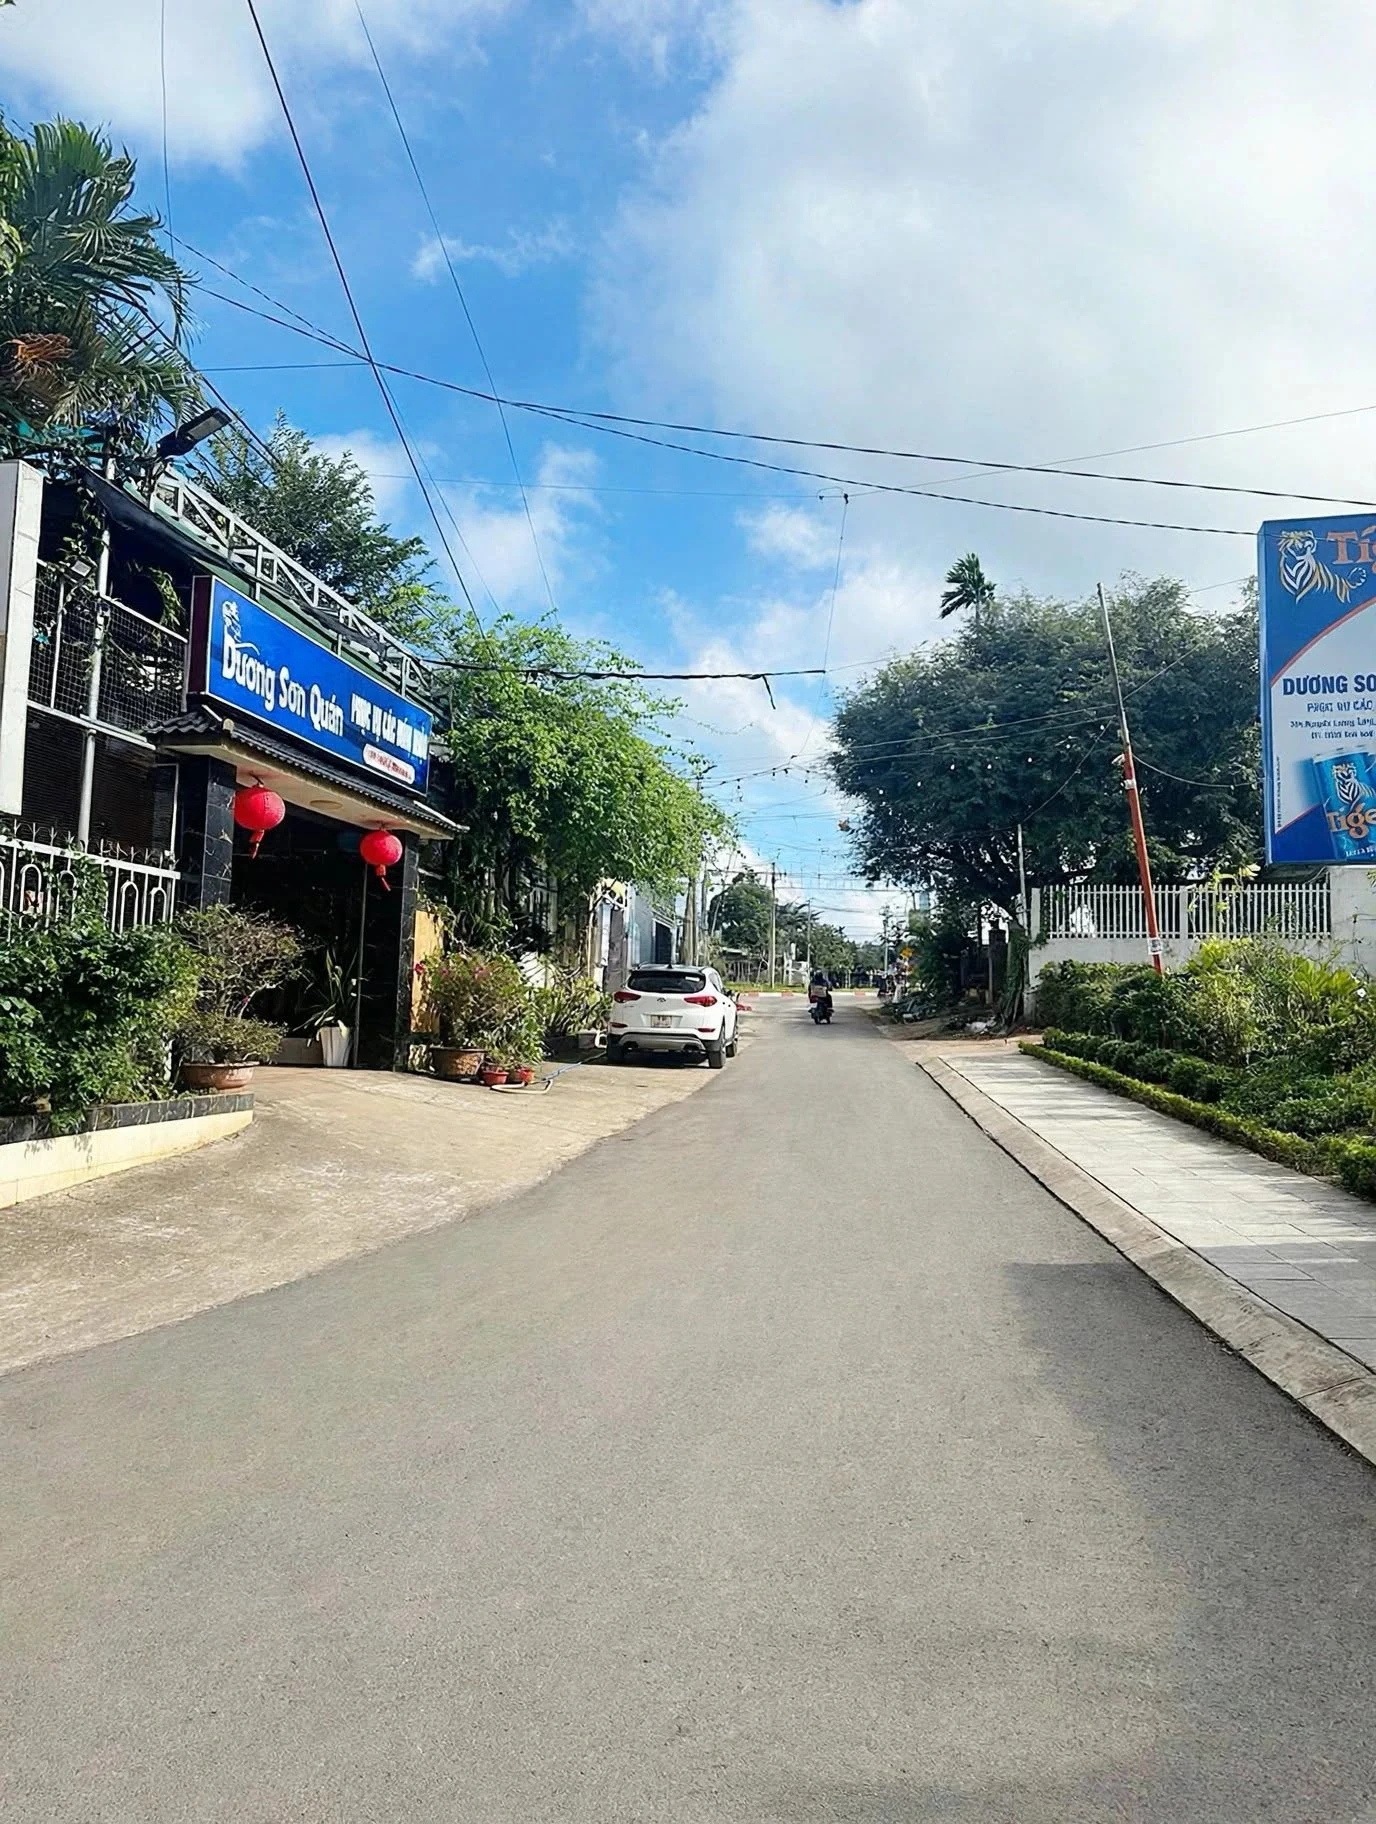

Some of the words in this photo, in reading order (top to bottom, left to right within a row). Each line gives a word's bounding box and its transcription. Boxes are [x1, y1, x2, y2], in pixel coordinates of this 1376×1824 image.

[1327, 525, 1376, 574] Ti
[1282, 674, 1348, 695] DƯƠNG
[310, 683, 344, 737] Quán
